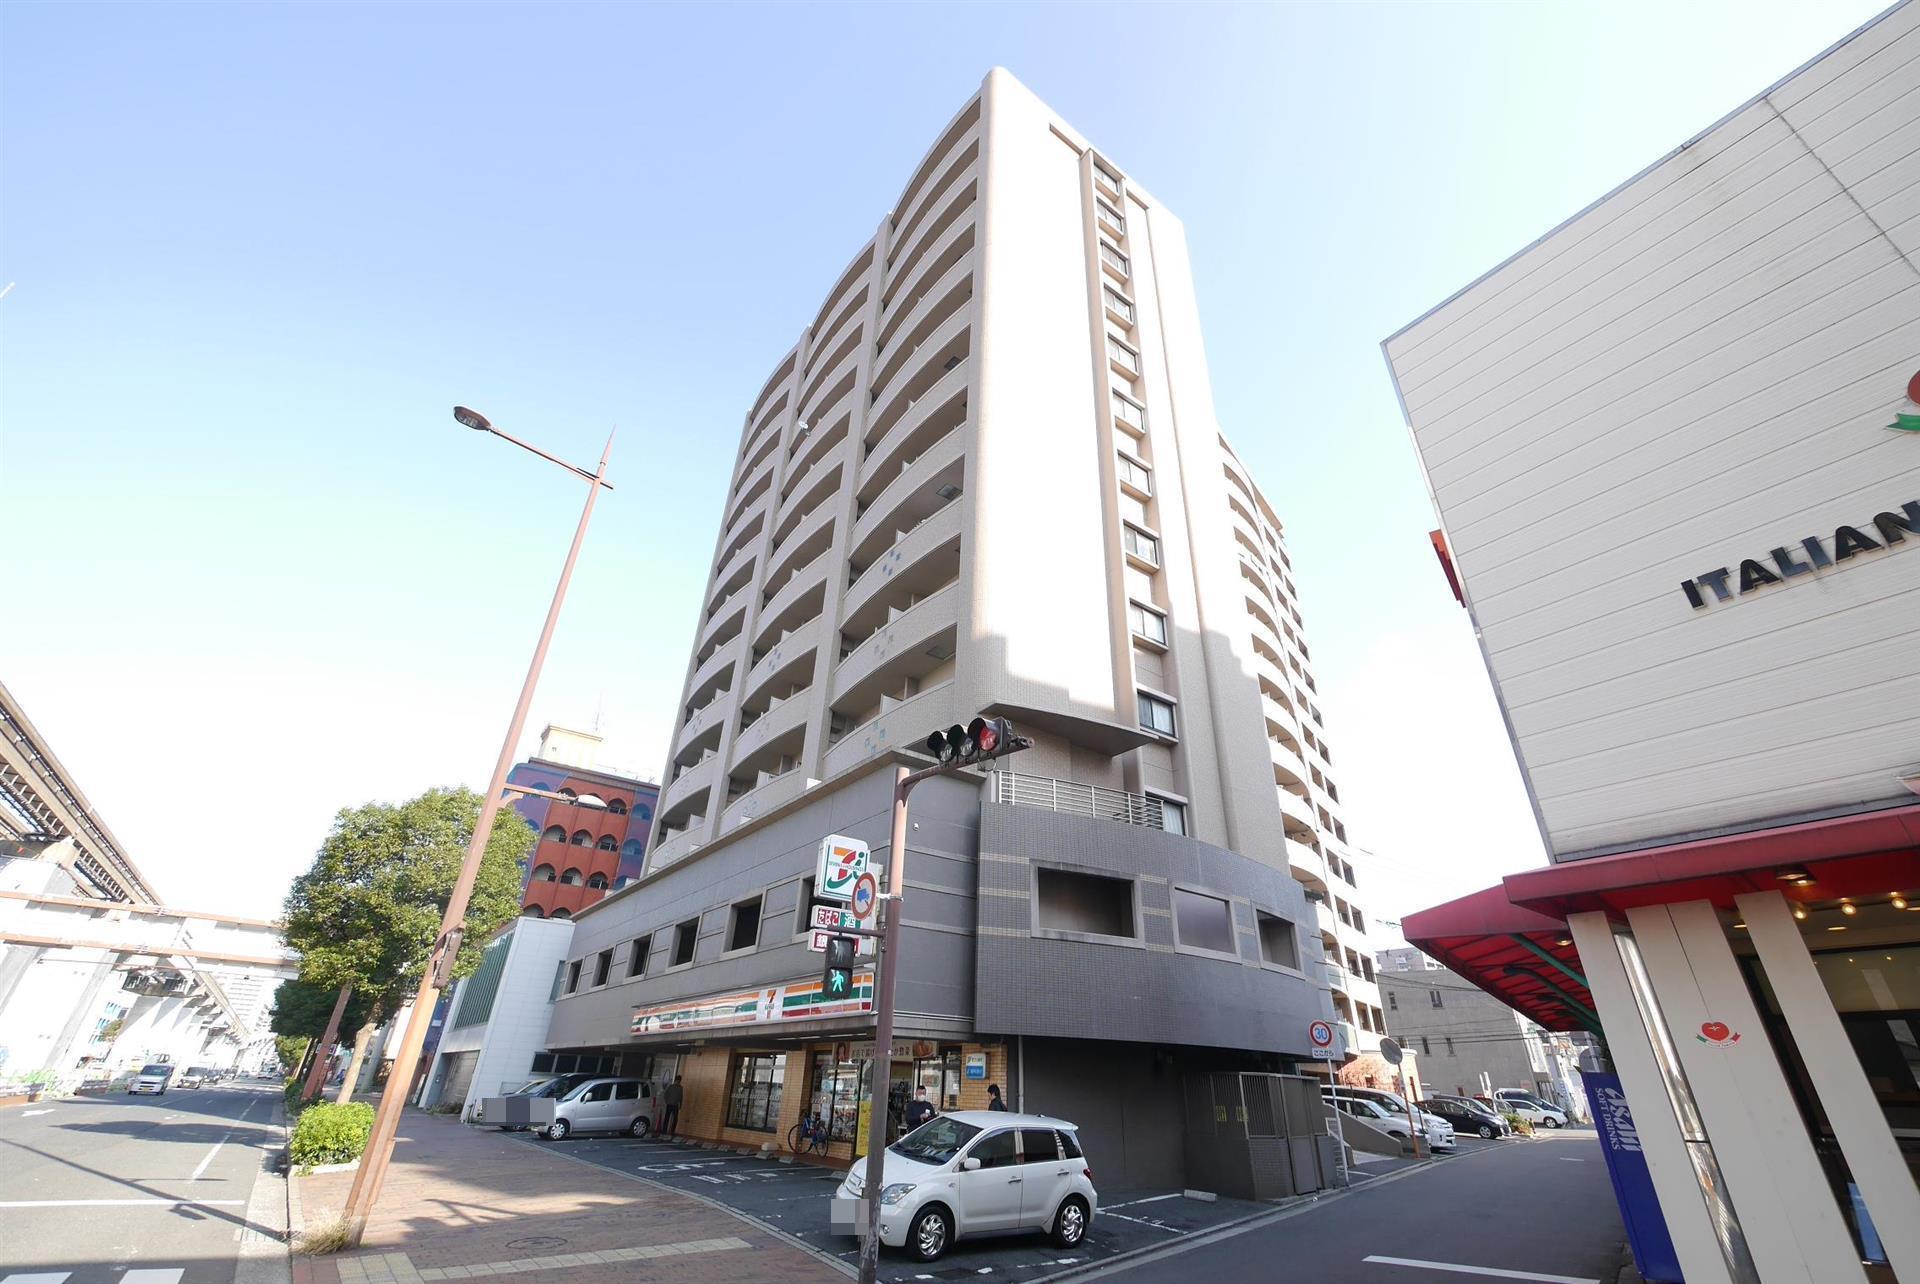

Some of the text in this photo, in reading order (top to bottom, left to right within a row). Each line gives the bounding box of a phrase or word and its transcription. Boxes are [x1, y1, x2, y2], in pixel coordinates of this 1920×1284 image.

[1681, 500, 1920, 610] ITALIAN
[818, 909, 856, 928] たばこ 酒
[1315, 1027, 1328, 1040] 30
[1595, 1087, 1621, 1150] SOFT DRINKS
